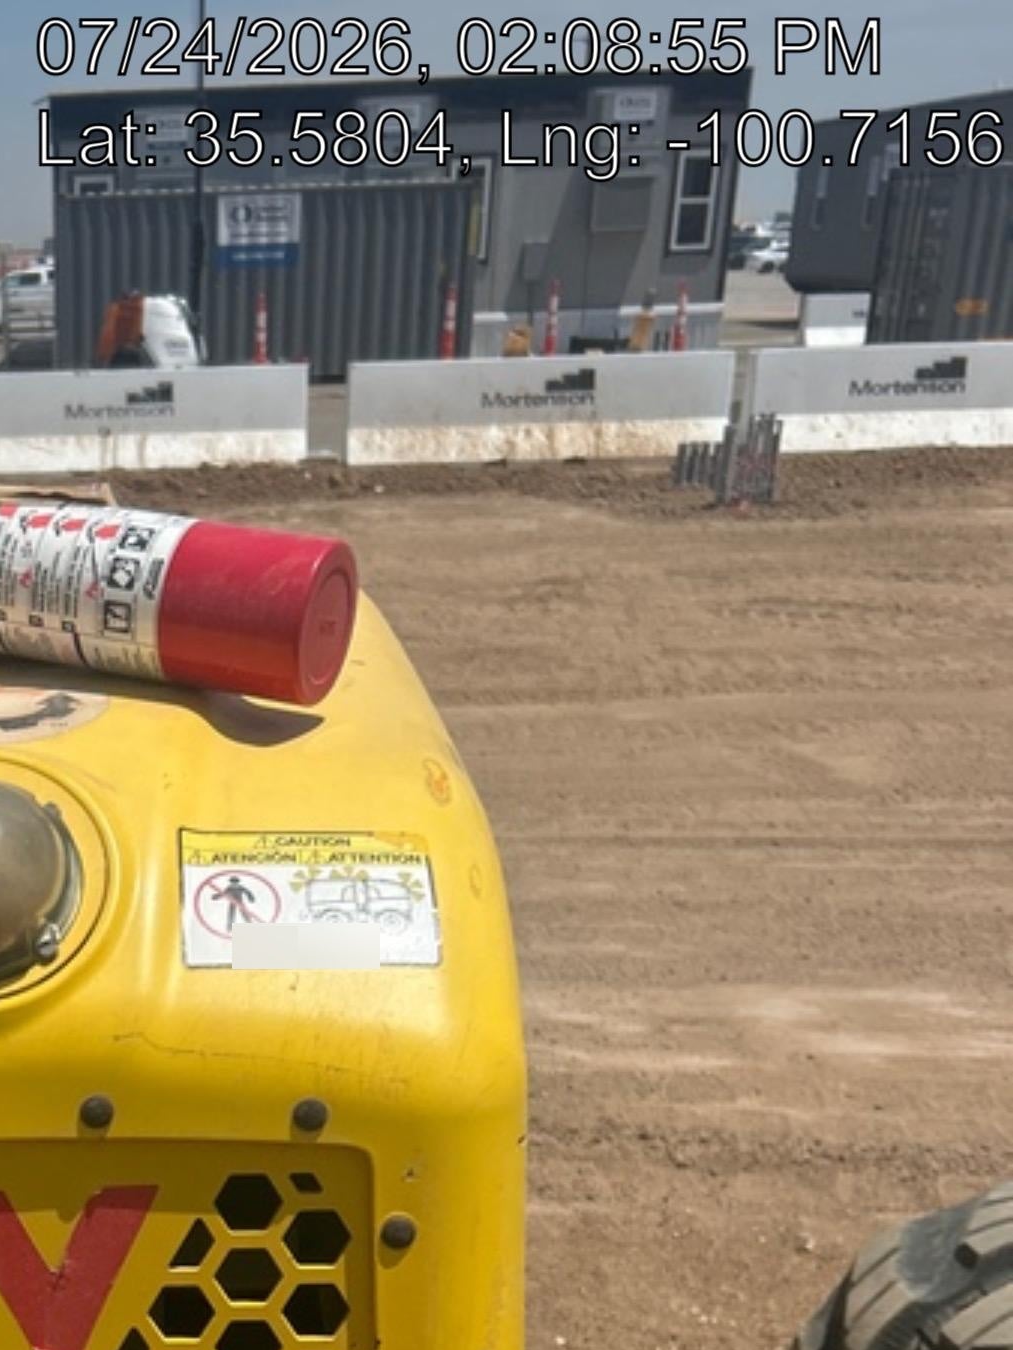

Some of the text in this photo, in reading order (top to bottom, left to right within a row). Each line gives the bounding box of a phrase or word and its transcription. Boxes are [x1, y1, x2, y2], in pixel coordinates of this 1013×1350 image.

[848, 379, 966, 397] Mortenson
[480, 391, 595, 408] Mortenson
[63, 404, 175, 420] Mortenson
[275, 835, 351, 848] CAUTION
[328, 852, 422, 864] ATTENTION
